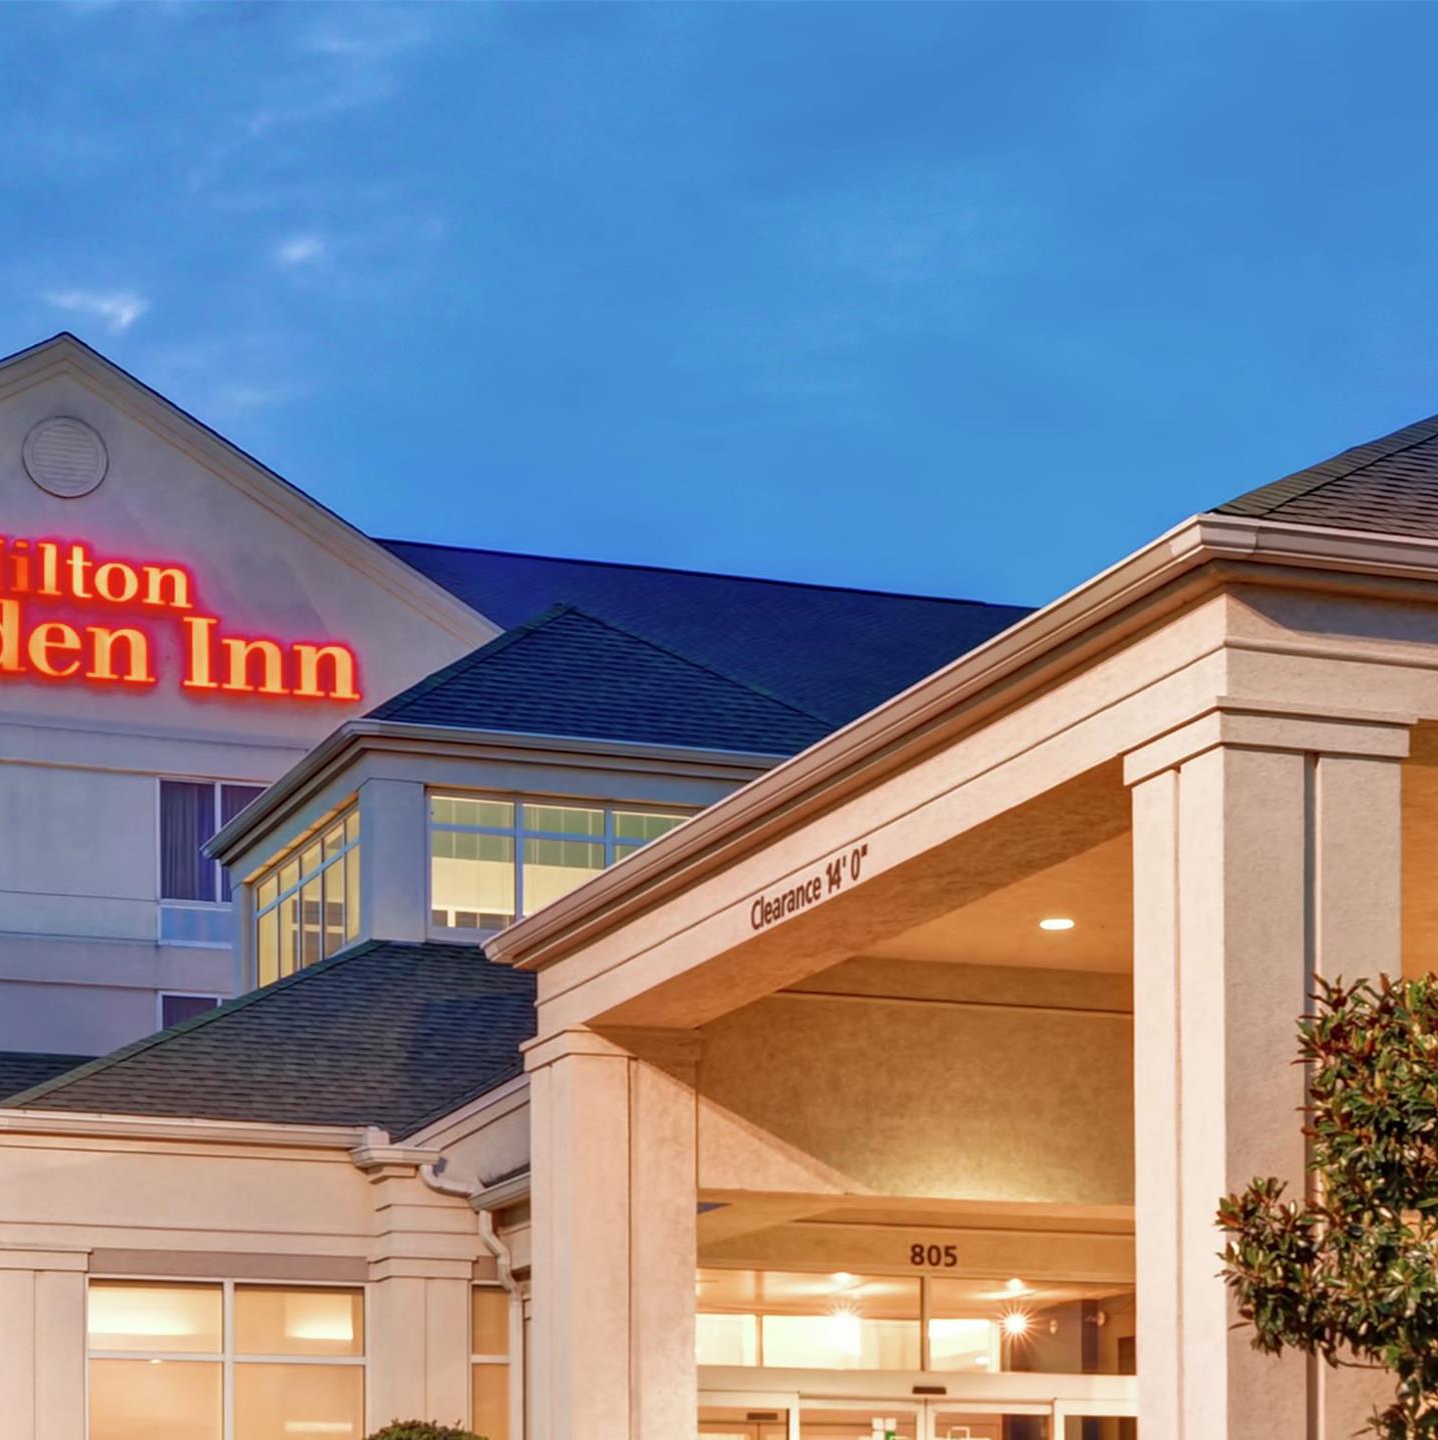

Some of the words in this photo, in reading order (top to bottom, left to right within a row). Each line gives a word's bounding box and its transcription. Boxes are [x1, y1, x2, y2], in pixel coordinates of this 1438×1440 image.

[181, 615, 362, 700] Inn
[751, 876, 822, 930] Clearance
[825, 855, 847, 893] 14'
[911, 1243, 958, 1267] 805
